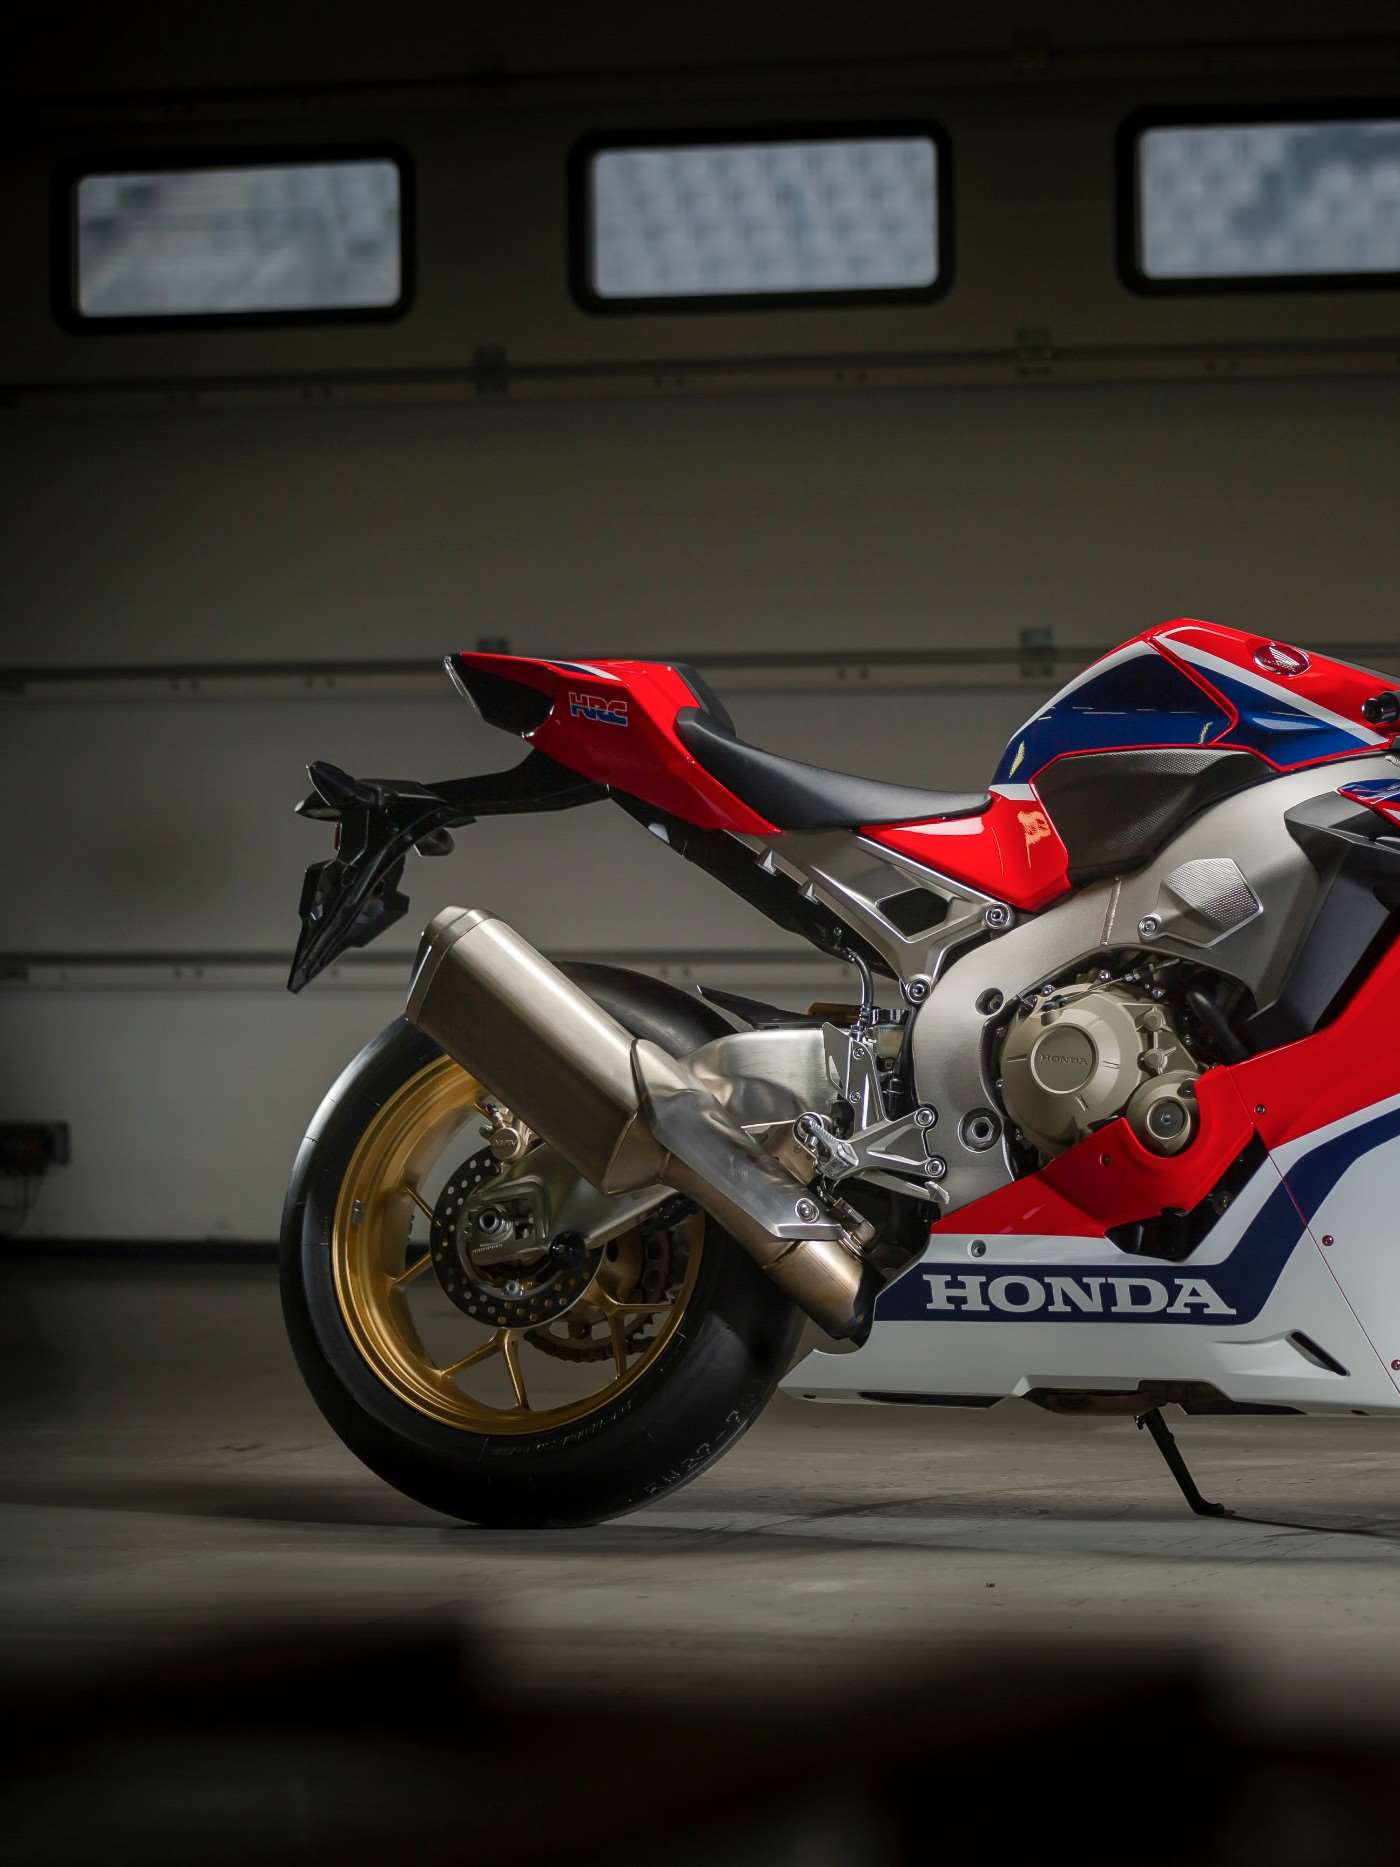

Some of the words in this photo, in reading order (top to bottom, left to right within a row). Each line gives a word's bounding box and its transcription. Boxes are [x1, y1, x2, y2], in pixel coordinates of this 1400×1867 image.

[569, 691, 628, 727] HRC
[1040, 1055, 1088, 1065] HONDA
[922, 1274, 1237, 1315] HONDA
